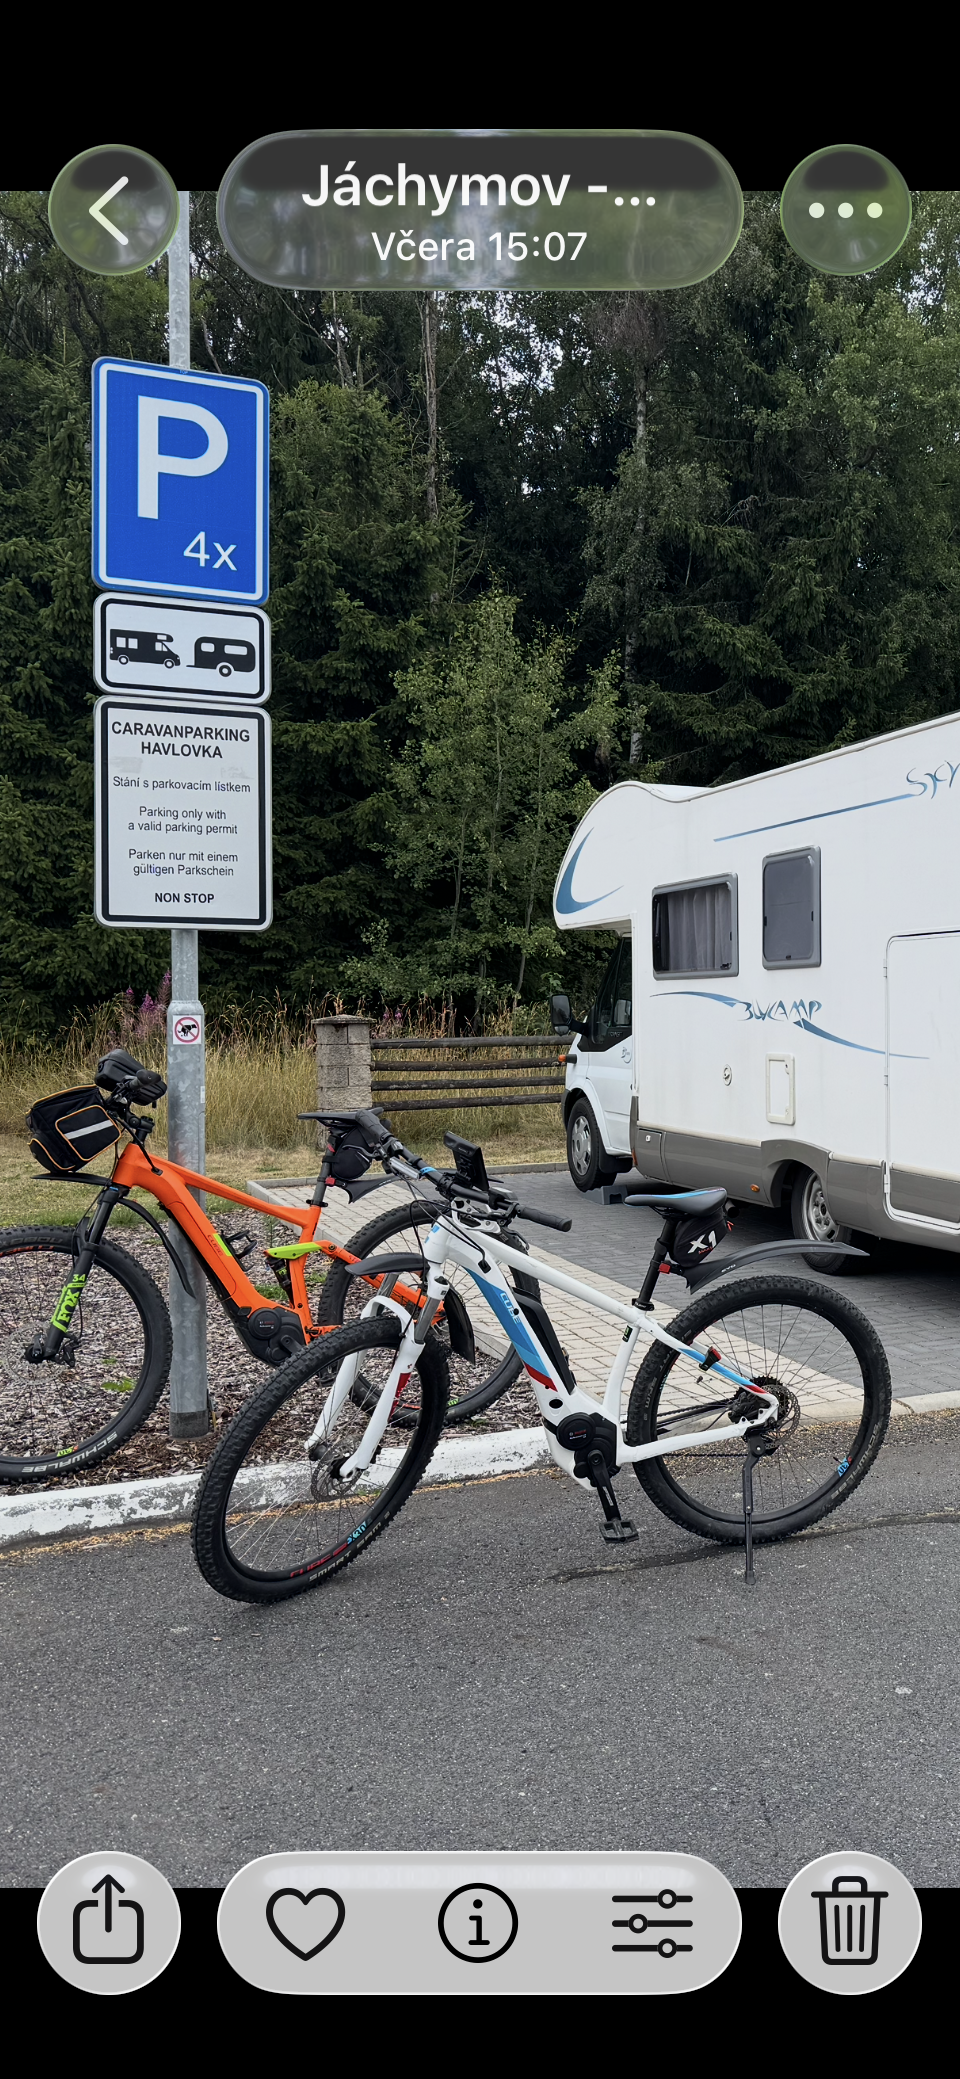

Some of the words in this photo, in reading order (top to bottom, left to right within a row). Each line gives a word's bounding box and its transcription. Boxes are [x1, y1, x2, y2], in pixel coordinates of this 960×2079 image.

[137, 395, 229, 520] P
[183, 531, 237, 571] 4x
[111, 721, 250, 742] CARAVANPARKING
[141, 741, 223, 759] HAVLOVKA
[113, 776, 140, 788] Stání
[143, 780, 149, 788] s
[152, 779, 211, 792] parkovacím
[214, 781, 251, 793] lístkem
[139, 806, 178, 820] Parking
[181, 809, 203, 821] only
[205, 809, 226, 820] with
[128, 823, 135, 831] a
[138, 821, 162, 831] valid
[165, 823, 203, 835] parking
[206, 824, 238, 835] permit
[128, 849, 166, 860] Parken
[169, 852, 186, 861] nur
[189, 851, 204, 862] mit
[207, 852, 238, 863] einem
[133, 863, 175, 877] gültigen
[177, 864, 234, 876] Parkschein
[155, 893, 180, 903] NON
[183, 893, 215, 904] STOP
[688, 1230, 717, 1254] X1
[73, 1274, 86, 1282] 34
[57, 1289, 80, 1323] FOX
[22, 1431, 118, 1473] SCHWALBE
